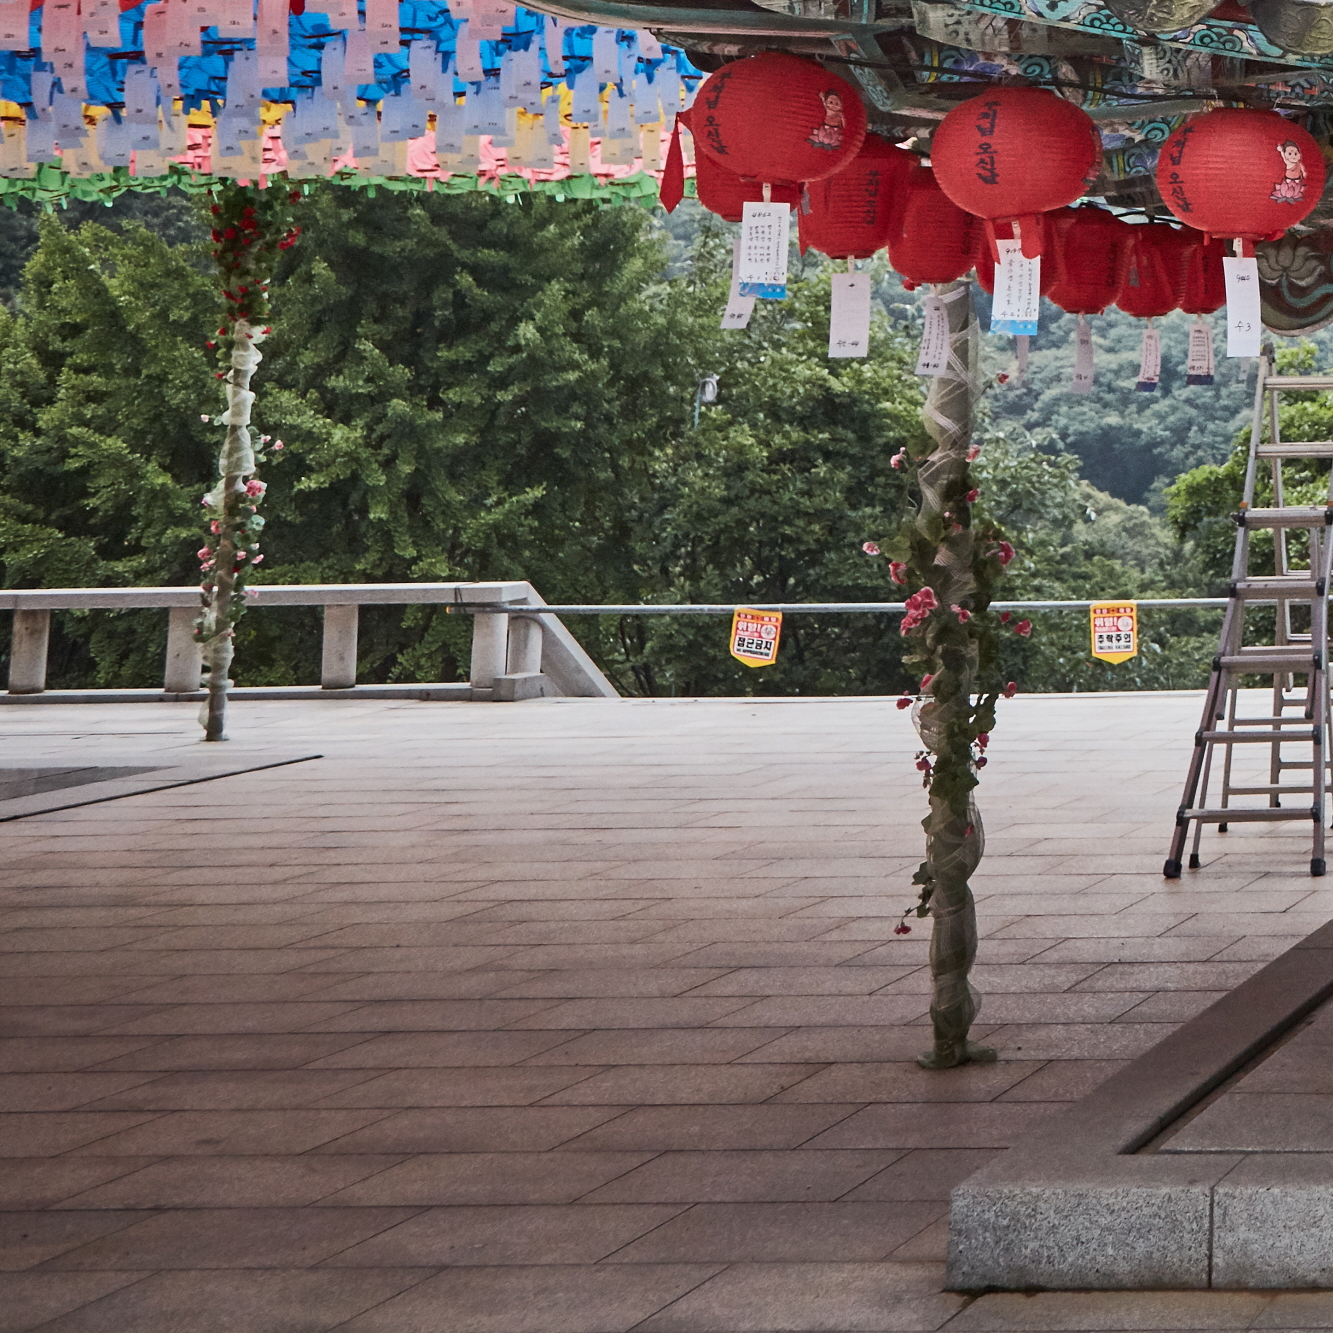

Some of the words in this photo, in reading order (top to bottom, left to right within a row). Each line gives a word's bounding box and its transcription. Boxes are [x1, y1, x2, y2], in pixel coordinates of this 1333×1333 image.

[975, 100, 1001, 136] 부처님
[974, 142, 999, 185] 오신날
[1235, 320, 1245, 332] 수
[1246, 322, 1252, 332] 3
[737, 636, 773, 652] 접근금지
[1097, 633, 1131, 644] 추락주의
